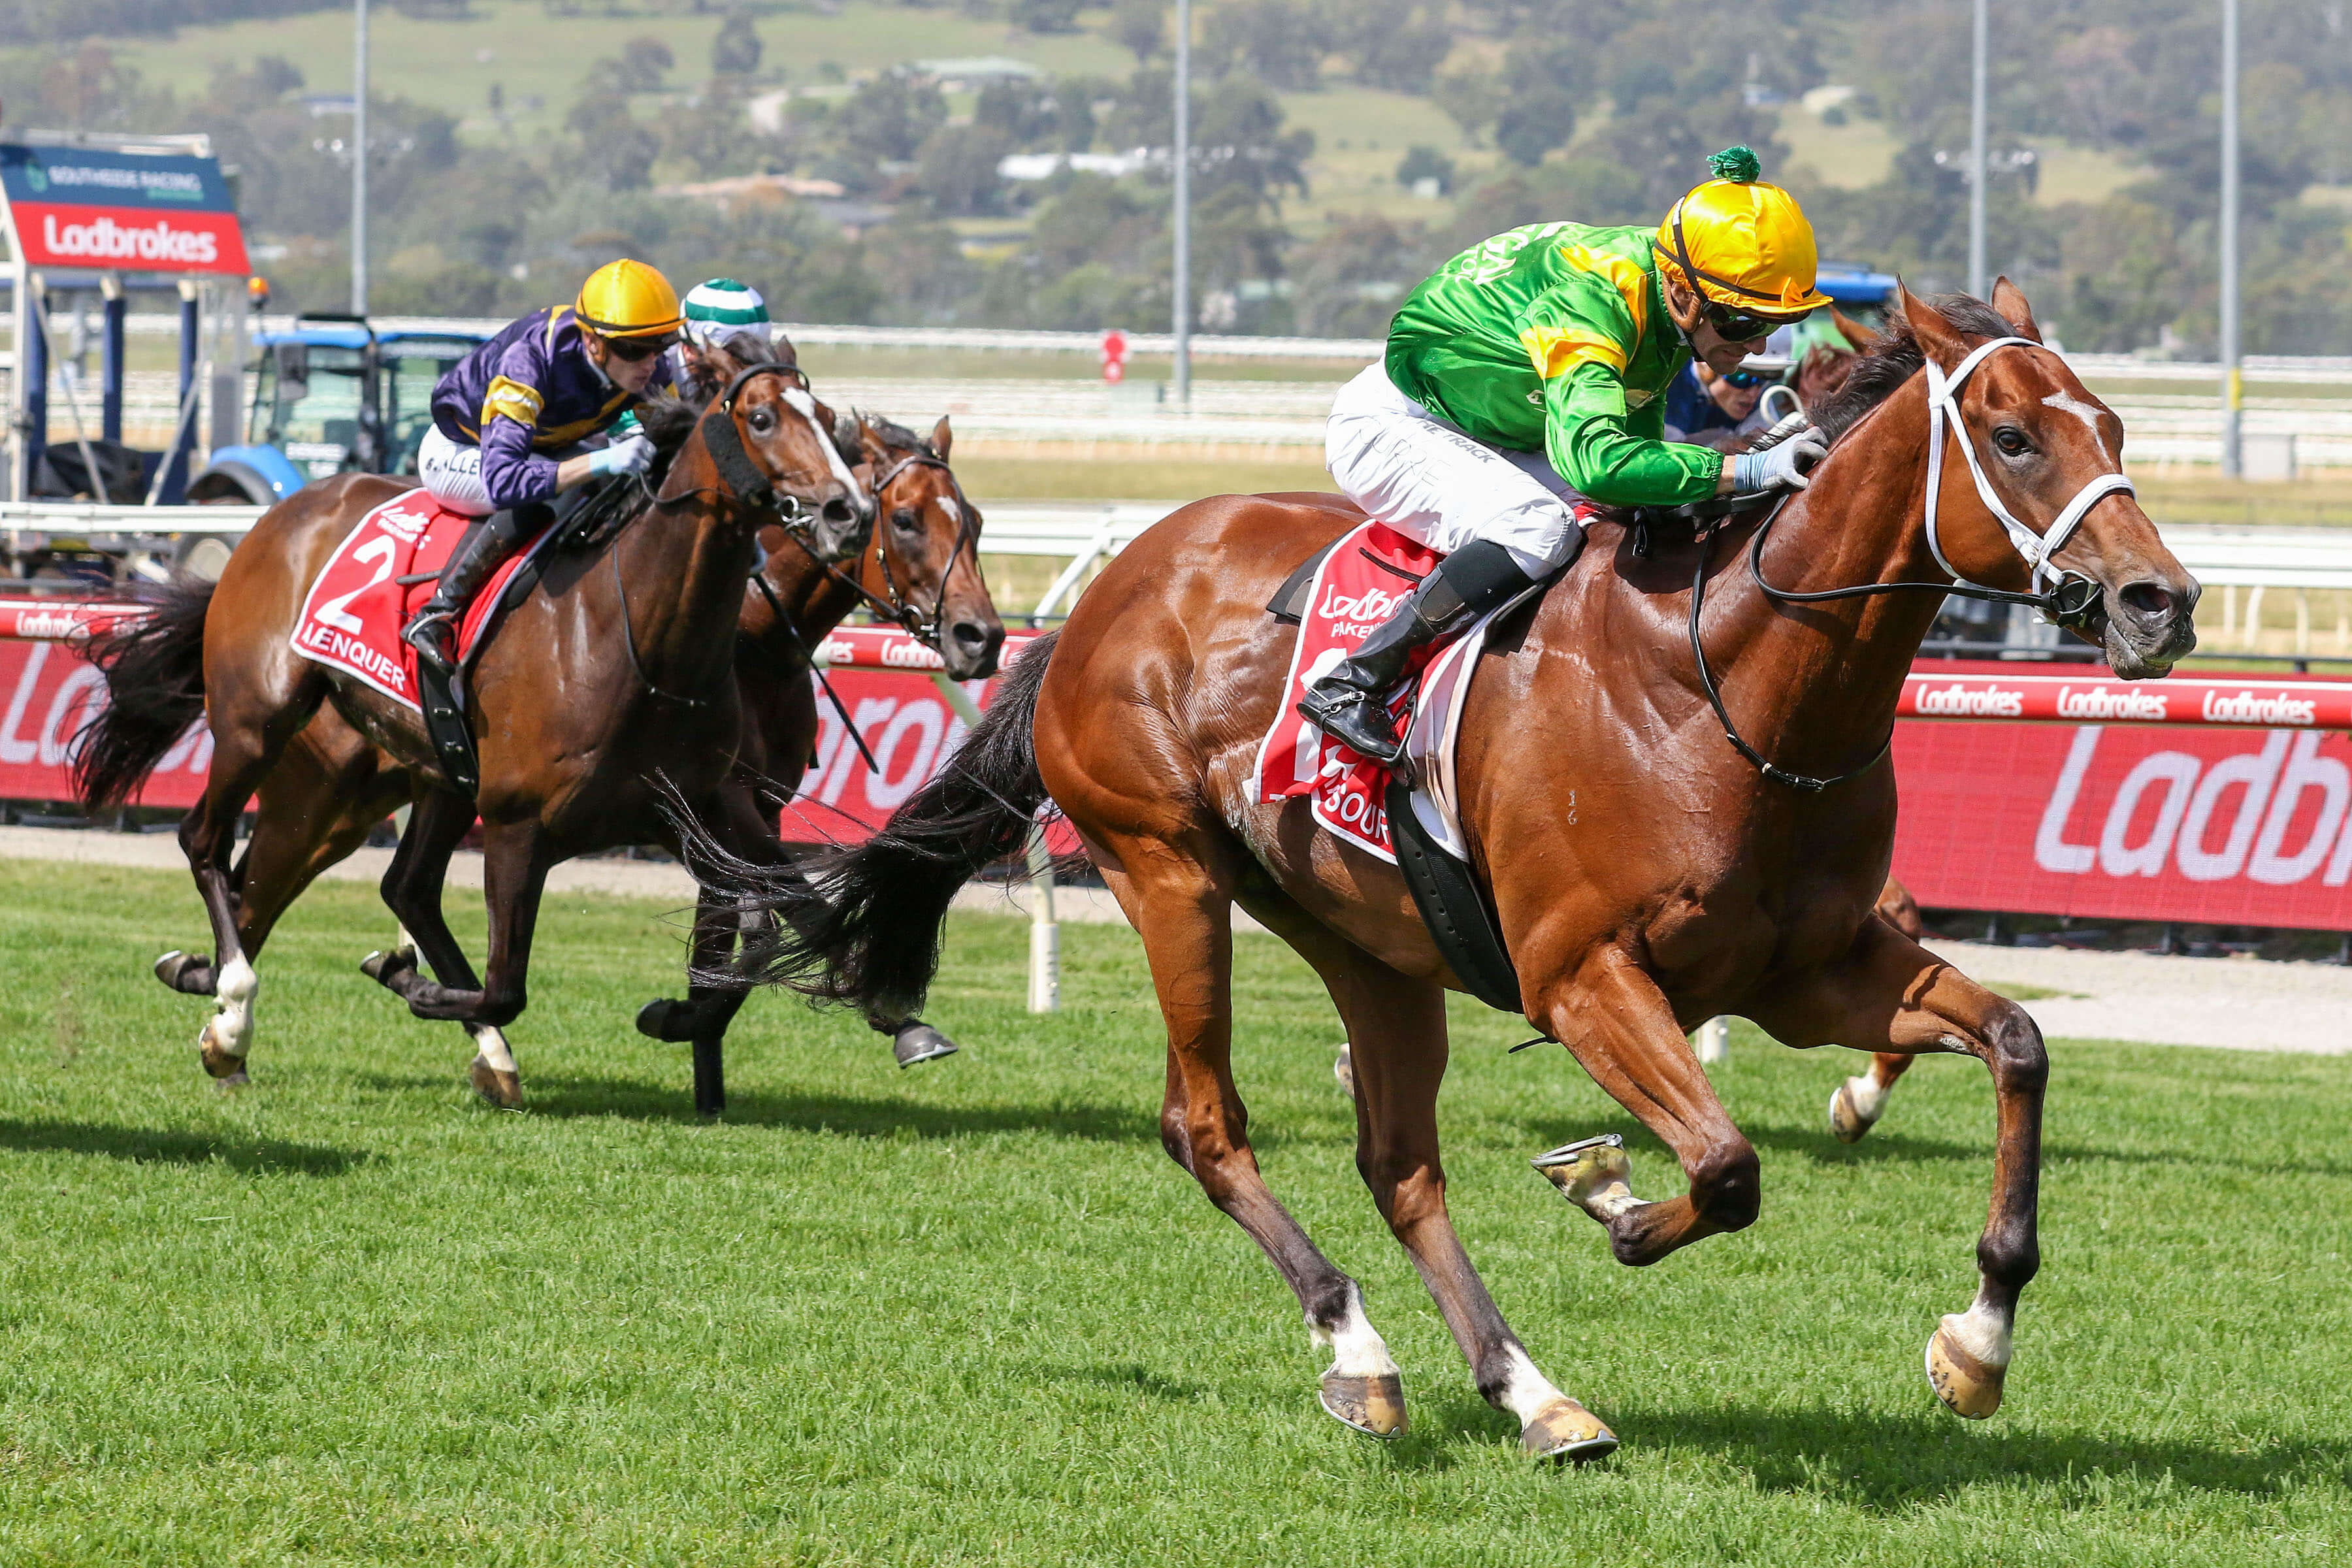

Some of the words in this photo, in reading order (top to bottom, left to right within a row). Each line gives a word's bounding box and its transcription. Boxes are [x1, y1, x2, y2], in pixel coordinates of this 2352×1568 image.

[43, 214, 218, 263] Ladbrokes
[1442, 434, 1497, 463] TRACK
[314, 534, 396, 635] 2
[1916, 683, 2023, 717] Ladbrokes
[2057, 686, 2168, 719] Ladbrokes
[2202, 689, 2315, 725] Ladbrokes
